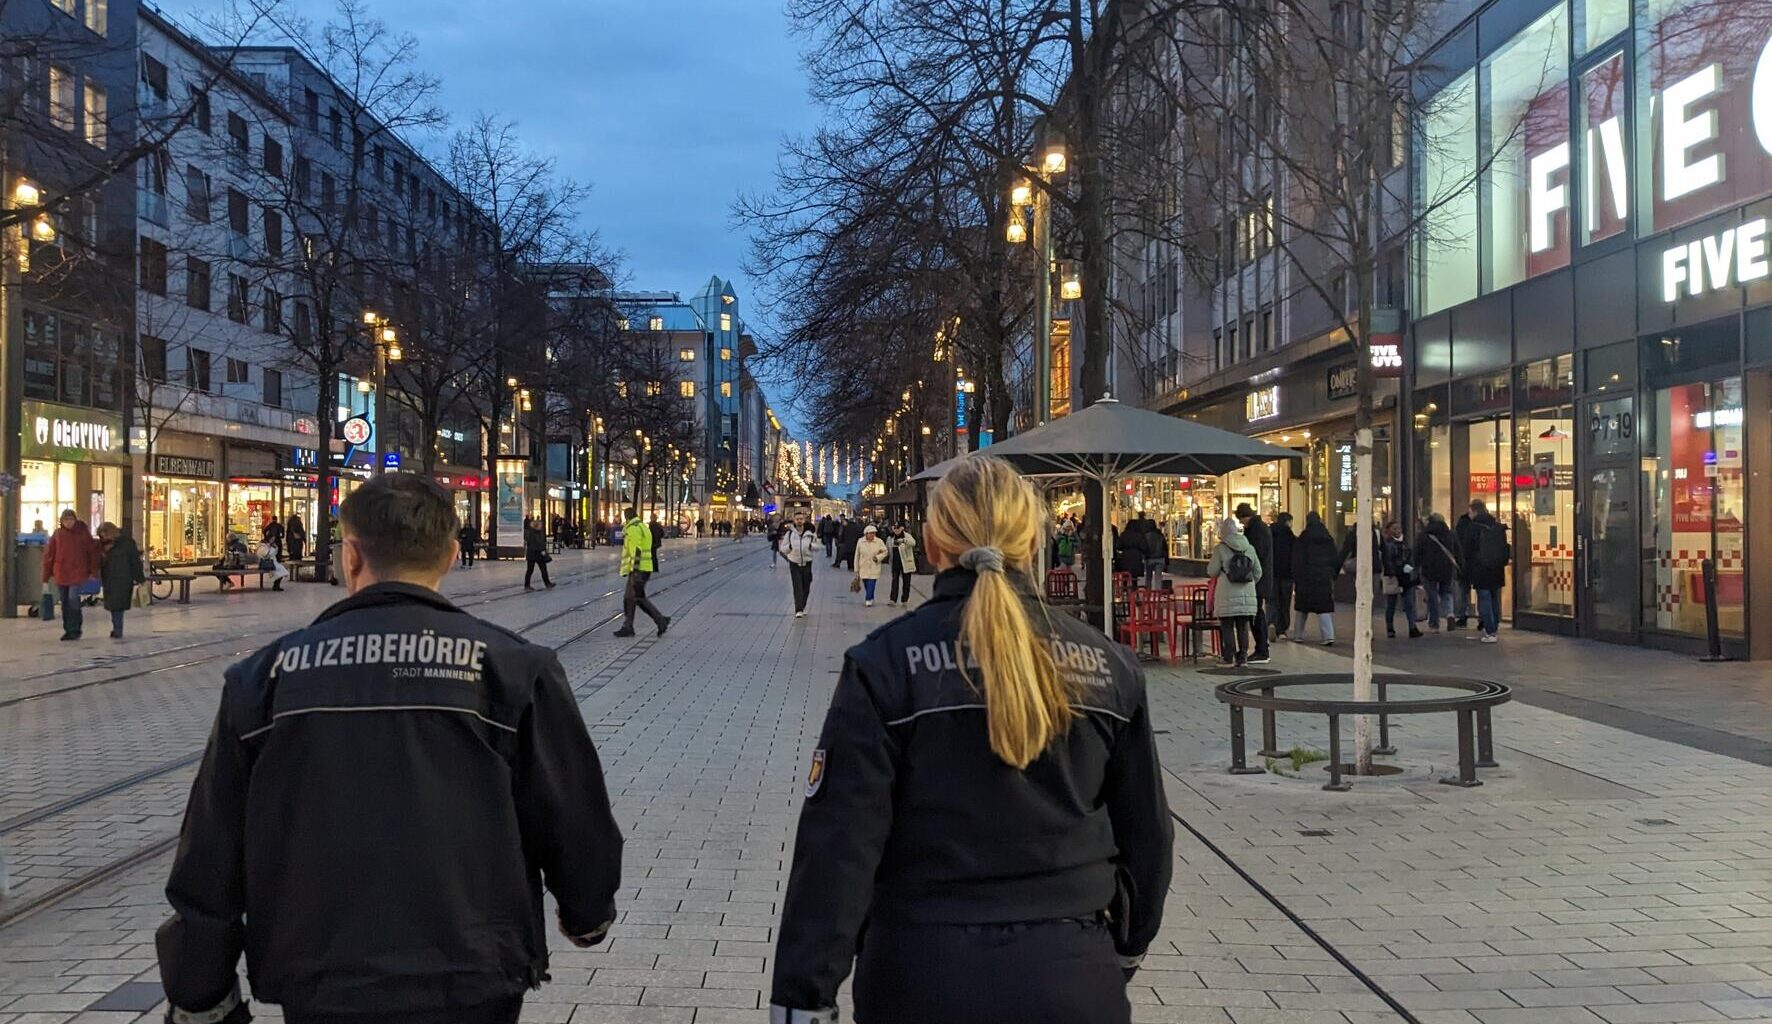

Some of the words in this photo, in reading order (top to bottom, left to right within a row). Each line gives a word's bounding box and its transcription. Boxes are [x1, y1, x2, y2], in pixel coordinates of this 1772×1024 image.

[1663, 218, 1769, 303] FIVE
[1370, 355, 1402, 367] UYS
[53, 418, 110, 452] OROVIVO
[1616, 411, 1632, 438] 19
[159, 457, 215, 477] ELBENWALD
[269, 629, 488, 679] POLIZEIBEHÖRDE
[392, 667, 421, 678] STADT
